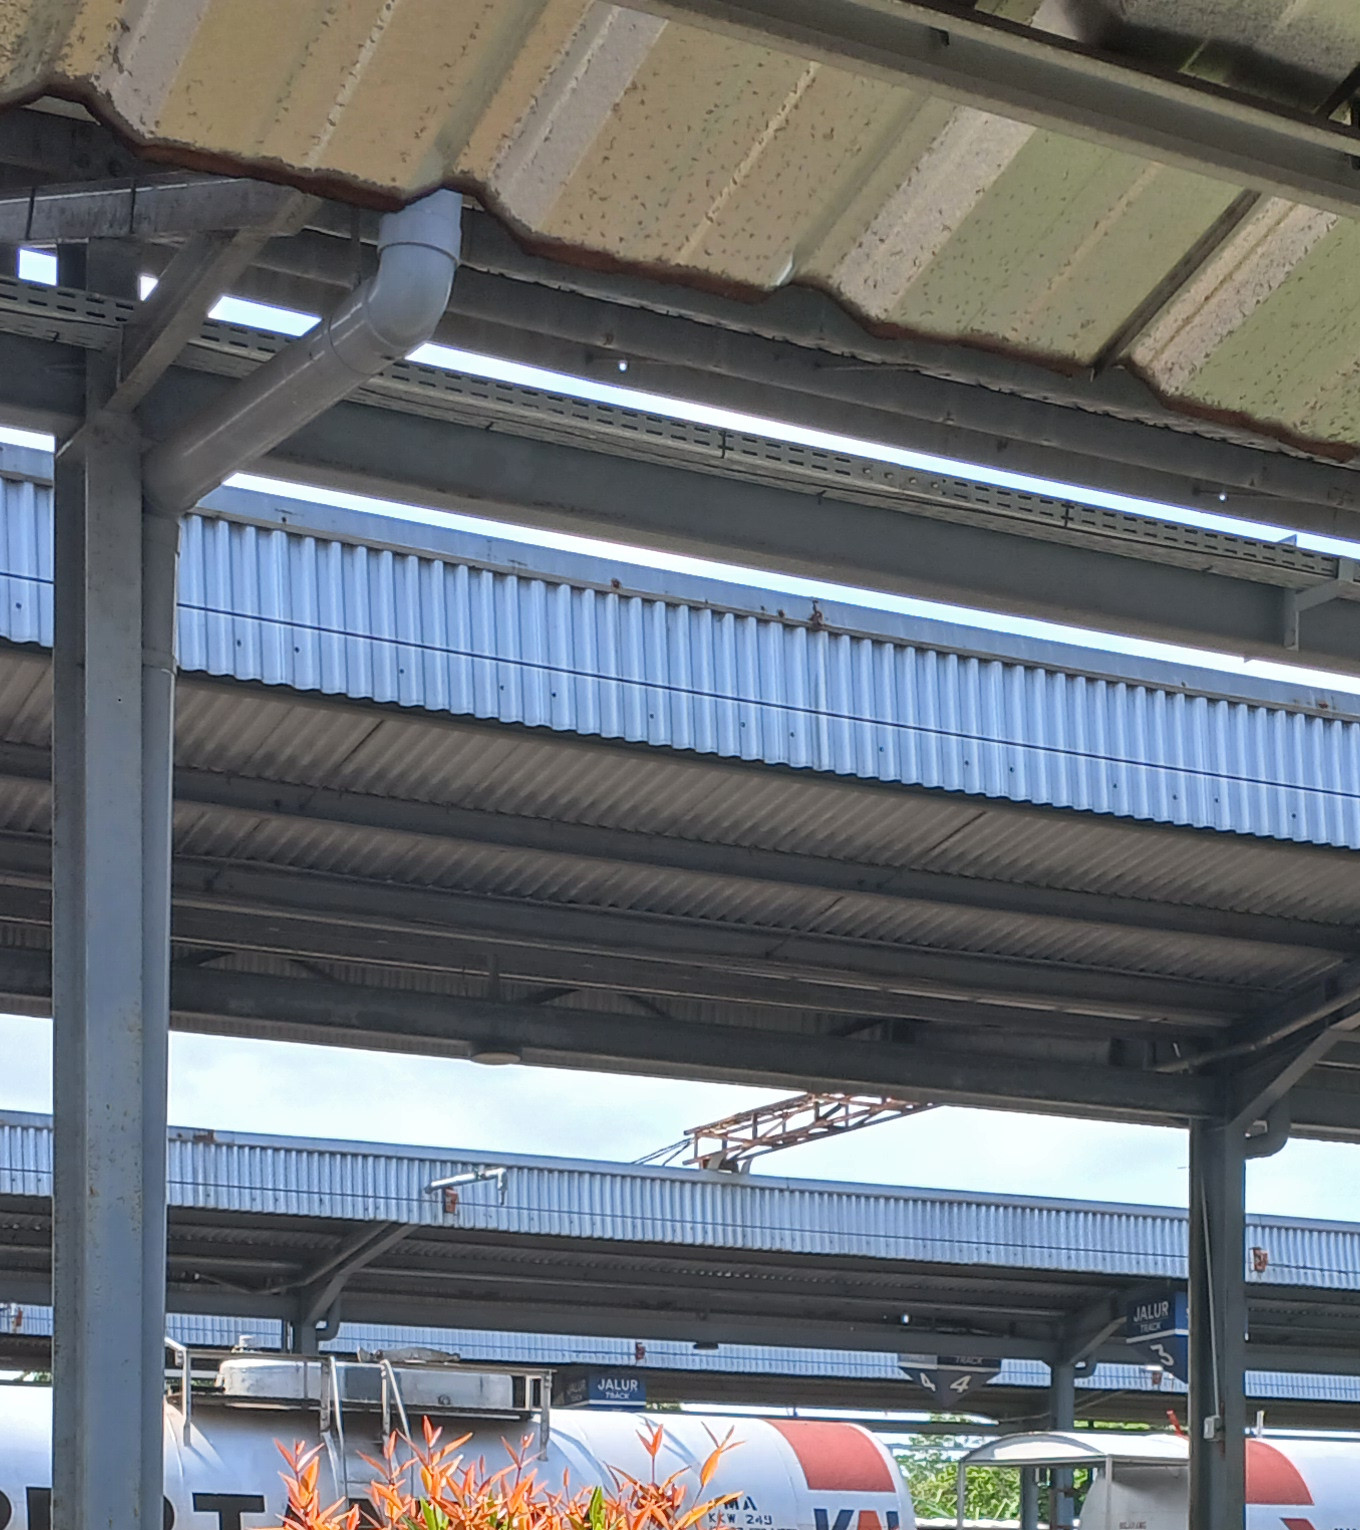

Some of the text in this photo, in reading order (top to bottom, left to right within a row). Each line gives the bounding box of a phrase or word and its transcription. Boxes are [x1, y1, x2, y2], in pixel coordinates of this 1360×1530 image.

[1133, 1301, 1169, 1322] JALUR
[1141, 1322, 1161, 1333] TRACK
[1150, 1344, 1174, 1366] 3
[597, 1378, 638, 1392] JALUR
[920, 1372, 936, 1391] 4
[949, 1375, 972, 1393] 4
[605, 1391, 630, 1399] TRACK
[745, 1515, 773, 1526] 249
